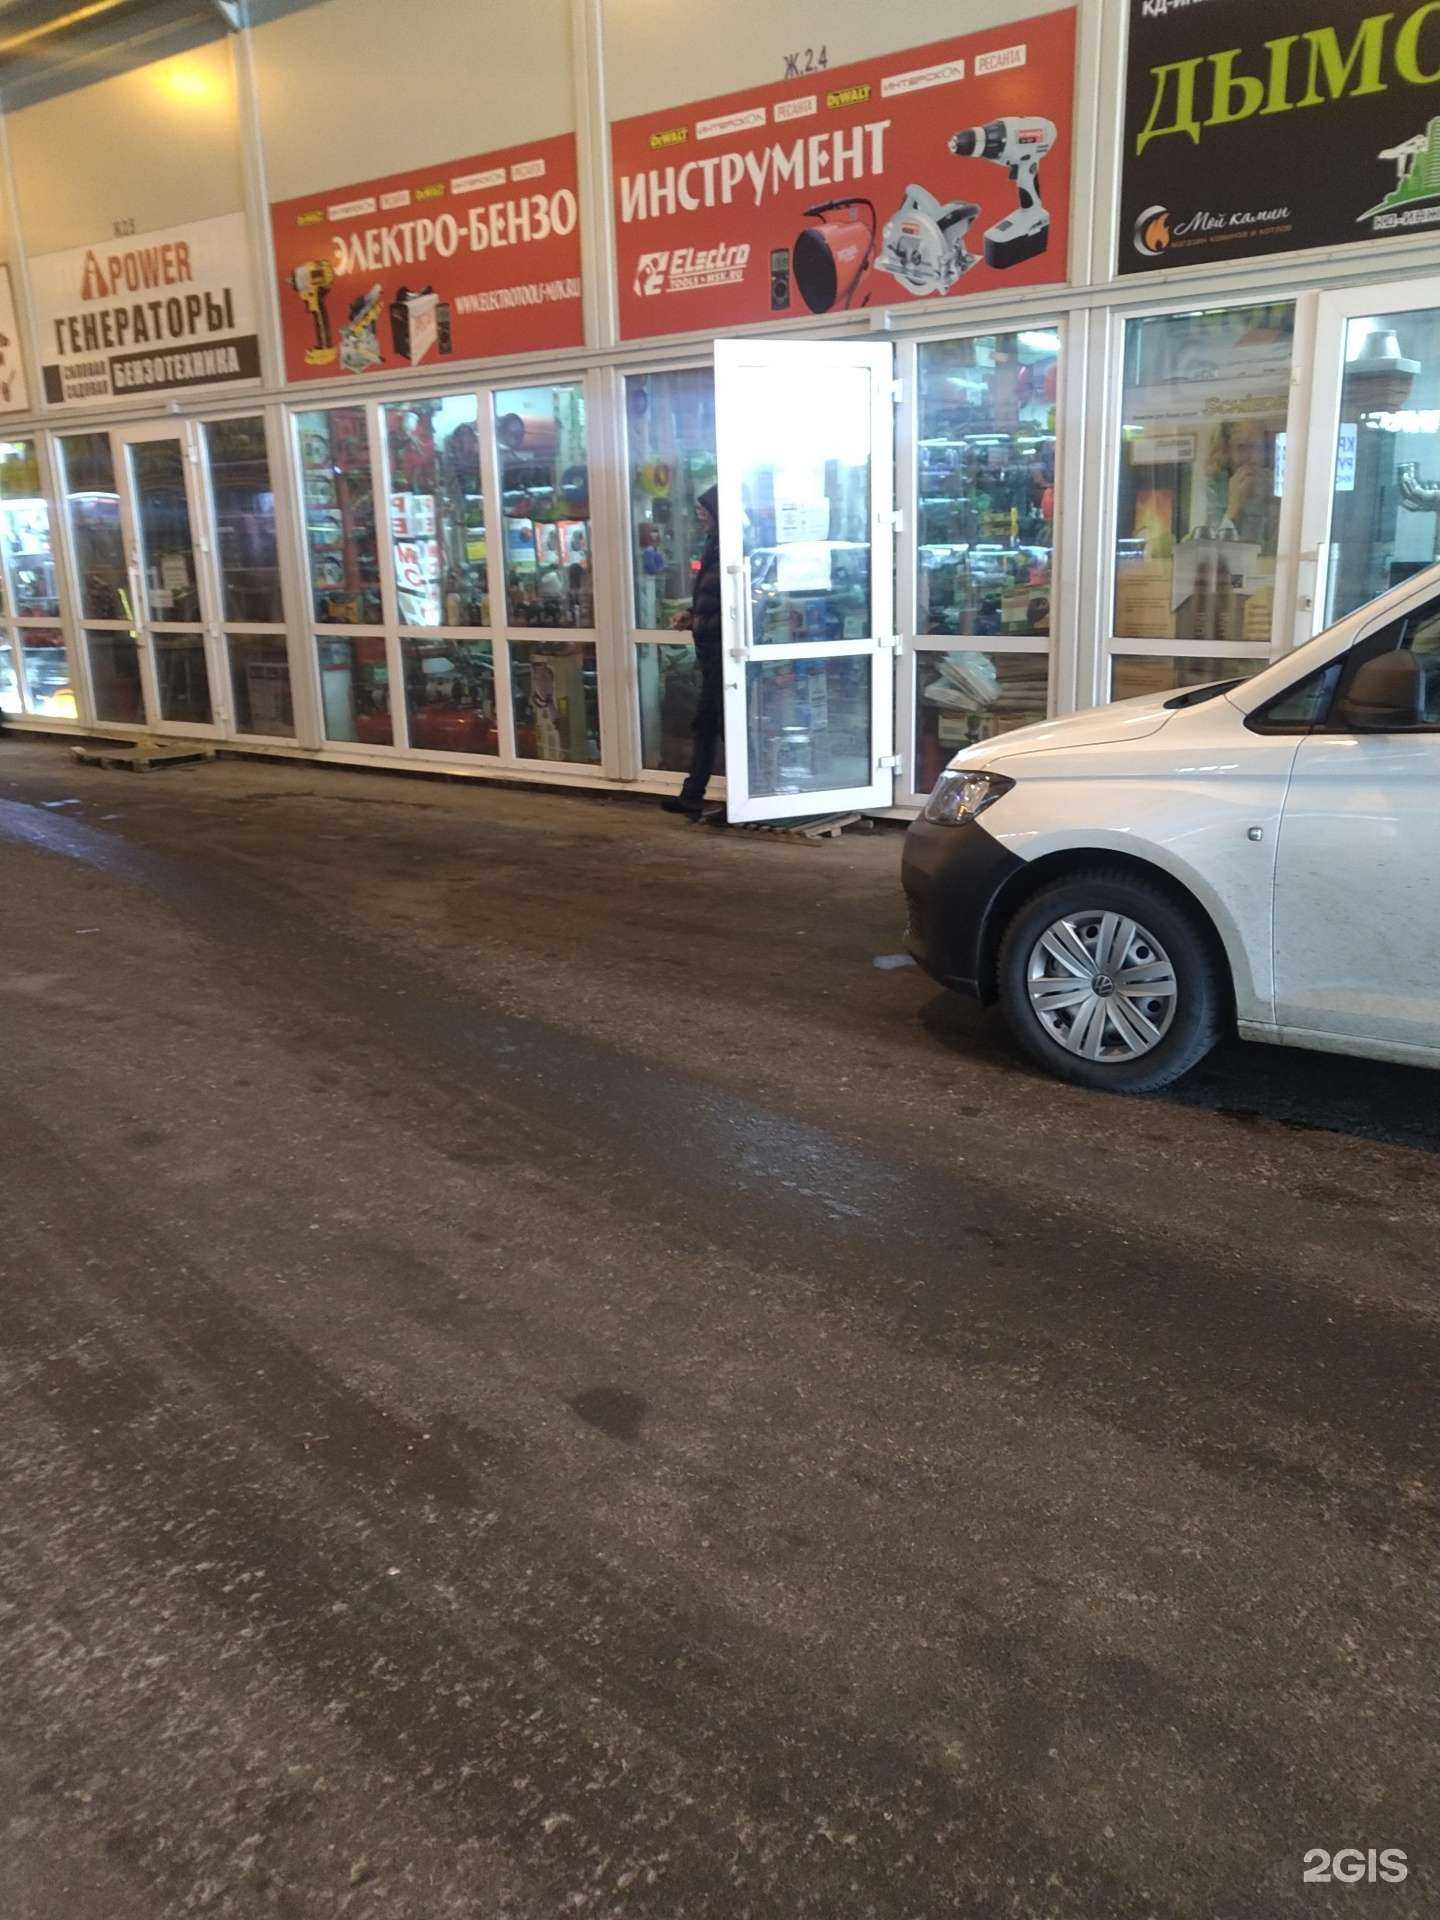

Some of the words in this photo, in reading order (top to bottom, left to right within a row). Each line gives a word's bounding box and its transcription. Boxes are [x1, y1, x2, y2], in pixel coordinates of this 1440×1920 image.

[620, 120, 891, 223] ИНСТРУМЕНТ
[331, 189, 577, 276] ЭЛЕКТРО-БЕНЗО
[1174, 211, 1226, 236] Мой
[1229, 207, 1291, 226] камин
[54, 288, 235, 355] ГЕНЕРАТОРЫ
[113, 346, 241, 388] БЕНЗОТЕХНИКА
